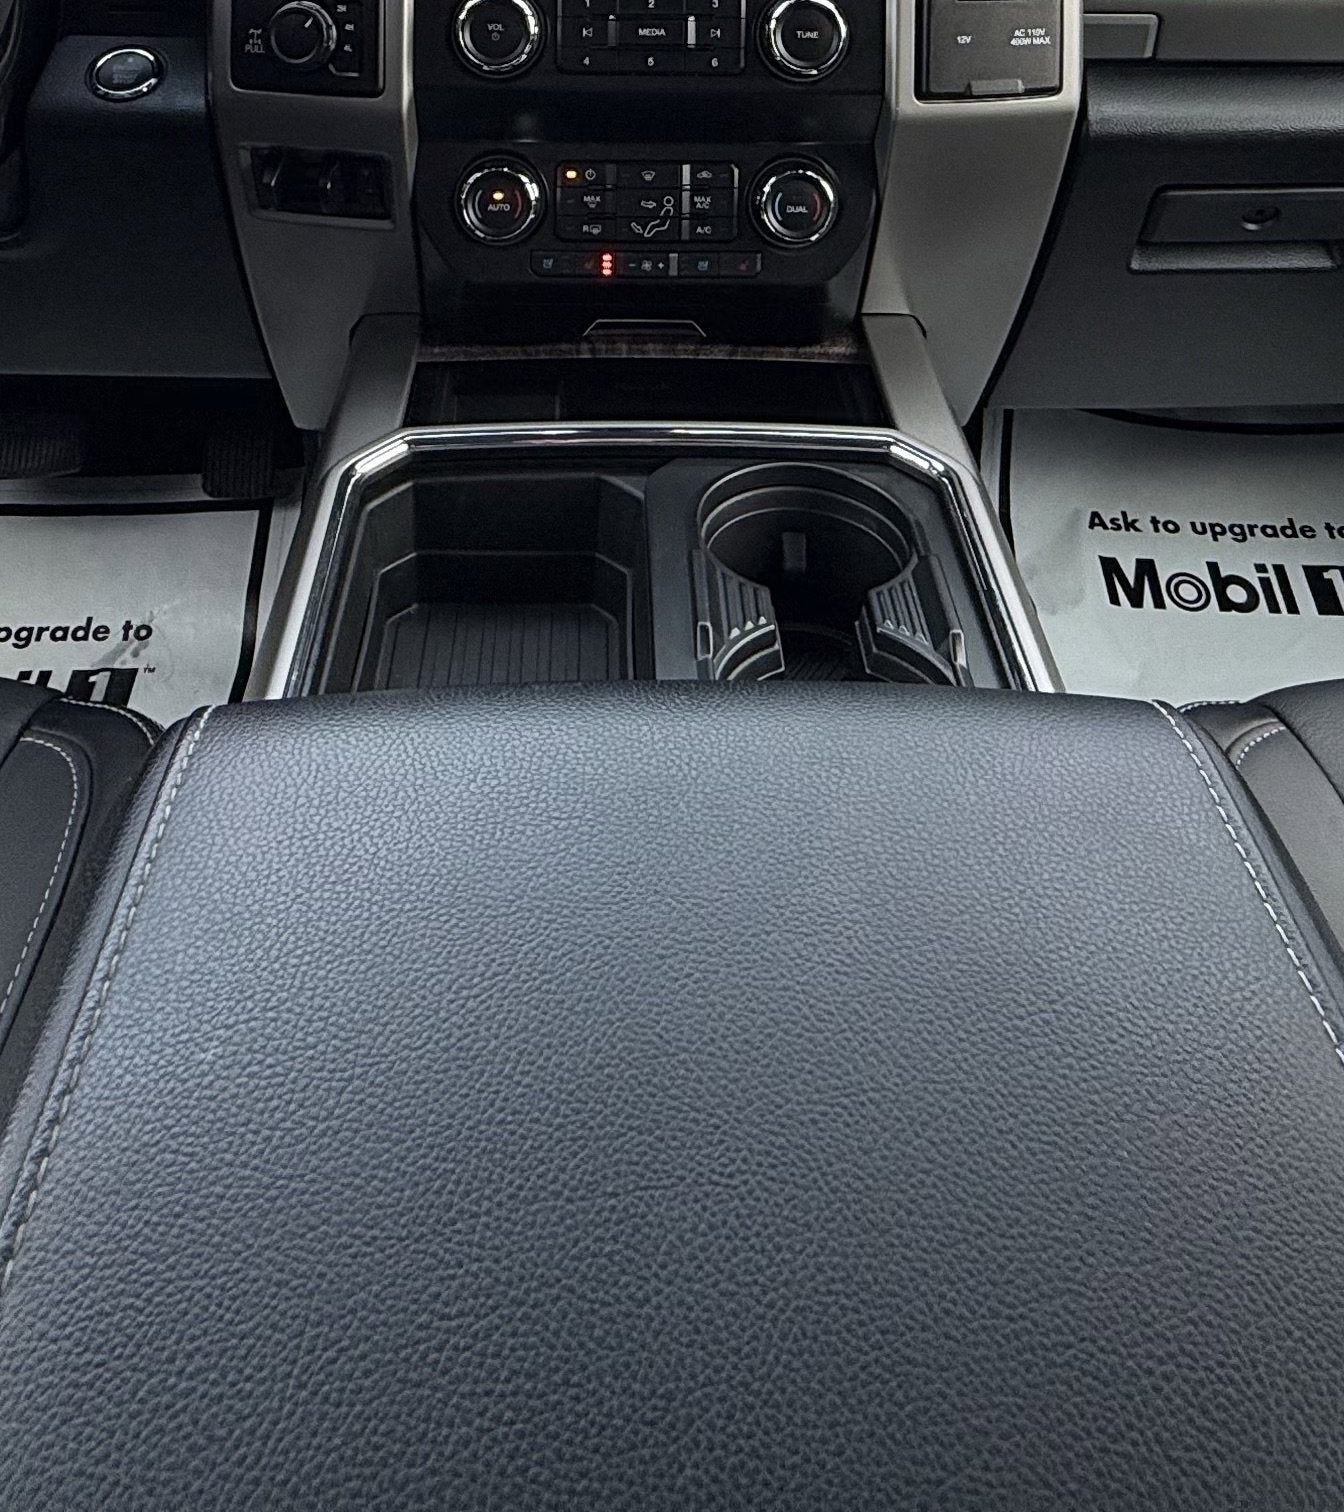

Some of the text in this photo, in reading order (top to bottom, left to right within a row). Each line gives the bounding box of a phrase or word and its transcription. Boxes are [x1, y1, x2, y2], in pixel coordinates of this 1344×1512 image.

[487, 23, 504, 31] VOL
[638, 27, 666, 37] MEDIA
[796, 30, 819, 39] TUNE
[956, 35, 972, 44] 12V
[1032, 36, 1052, 45] MAX
[583, 56, 590, 66] 4
[711, 57, 718, 68] 6
[487, 202, 510, 212] AUTO
[785, 204, 808, 214] DUAL
[696, 226, 712, 234] A/C
[1088, 509, 1141, 534] Ask
[1150, 513, 1181, 535] to
[1189, 517, 1317, 544] upgrade
[1098, 554, 1302, 616] Mobil
[121, 618, 154, 643] to
